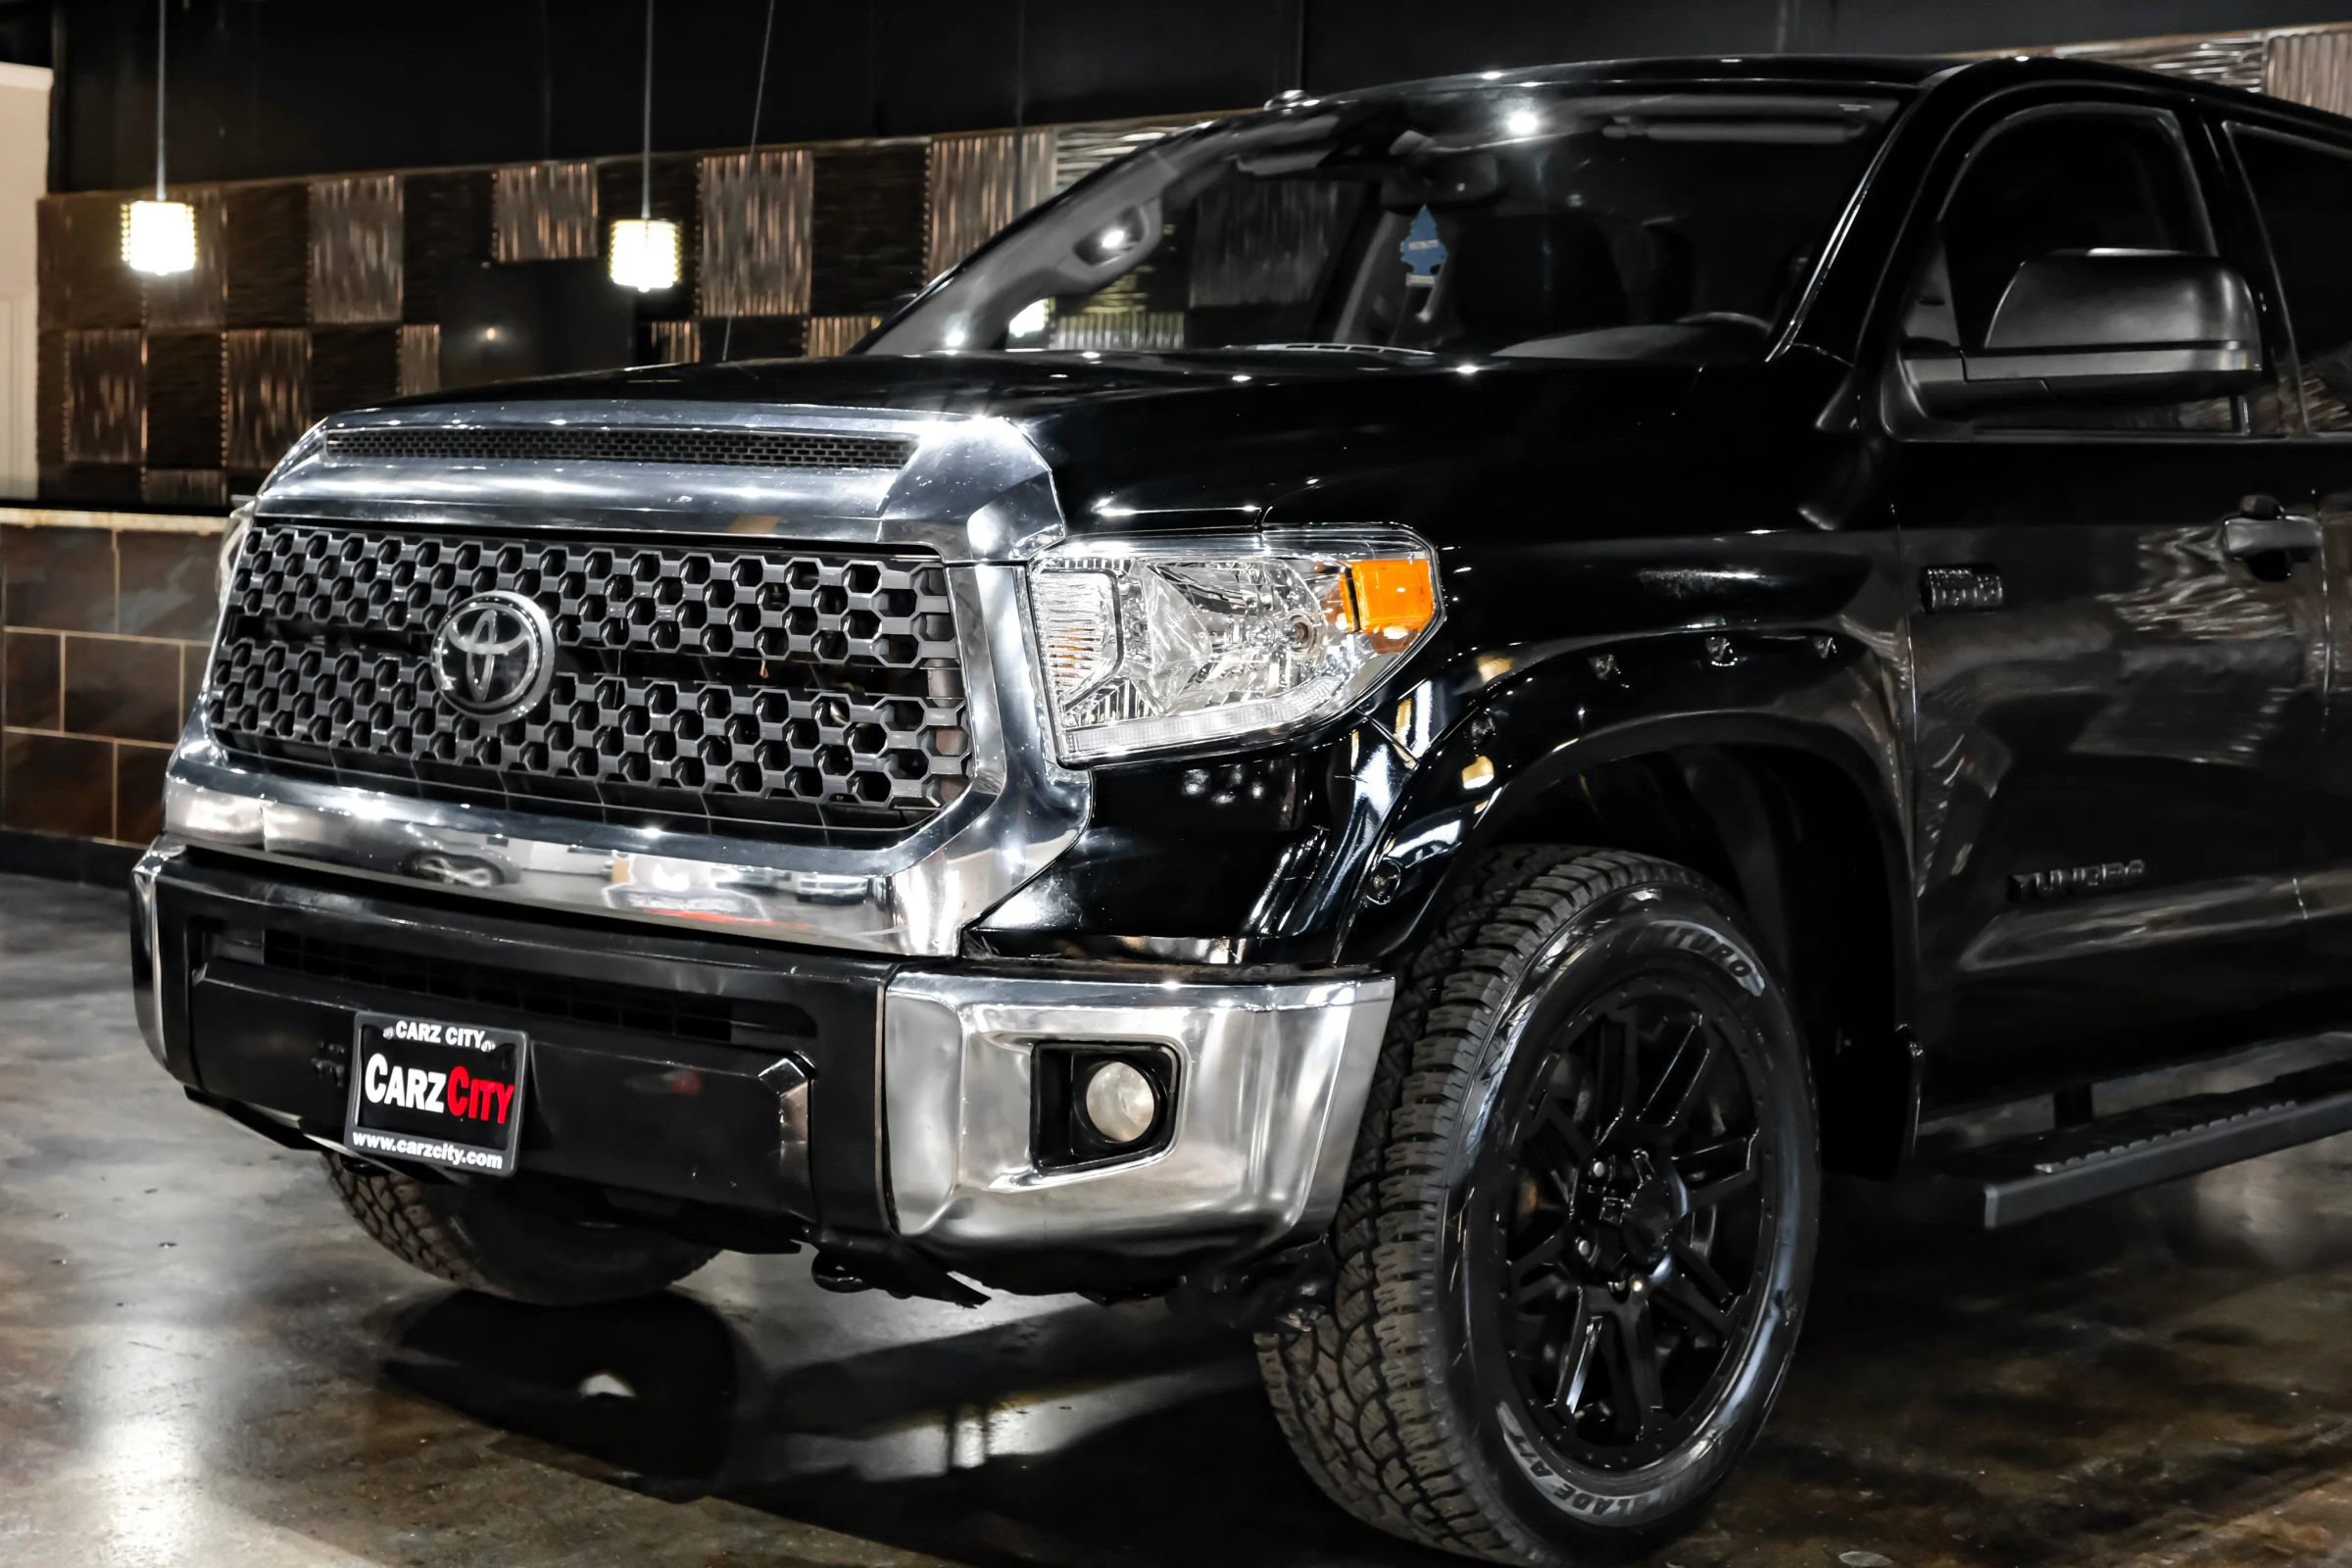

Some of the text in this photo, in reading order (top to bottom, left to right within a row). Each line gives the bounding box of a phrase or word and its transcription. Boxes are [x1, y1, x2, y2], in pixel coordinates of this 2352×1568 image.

[396, 1020, 486, 1050] CARZ CITY
[353, 1132, 503, 1169] www.carzcity.com
